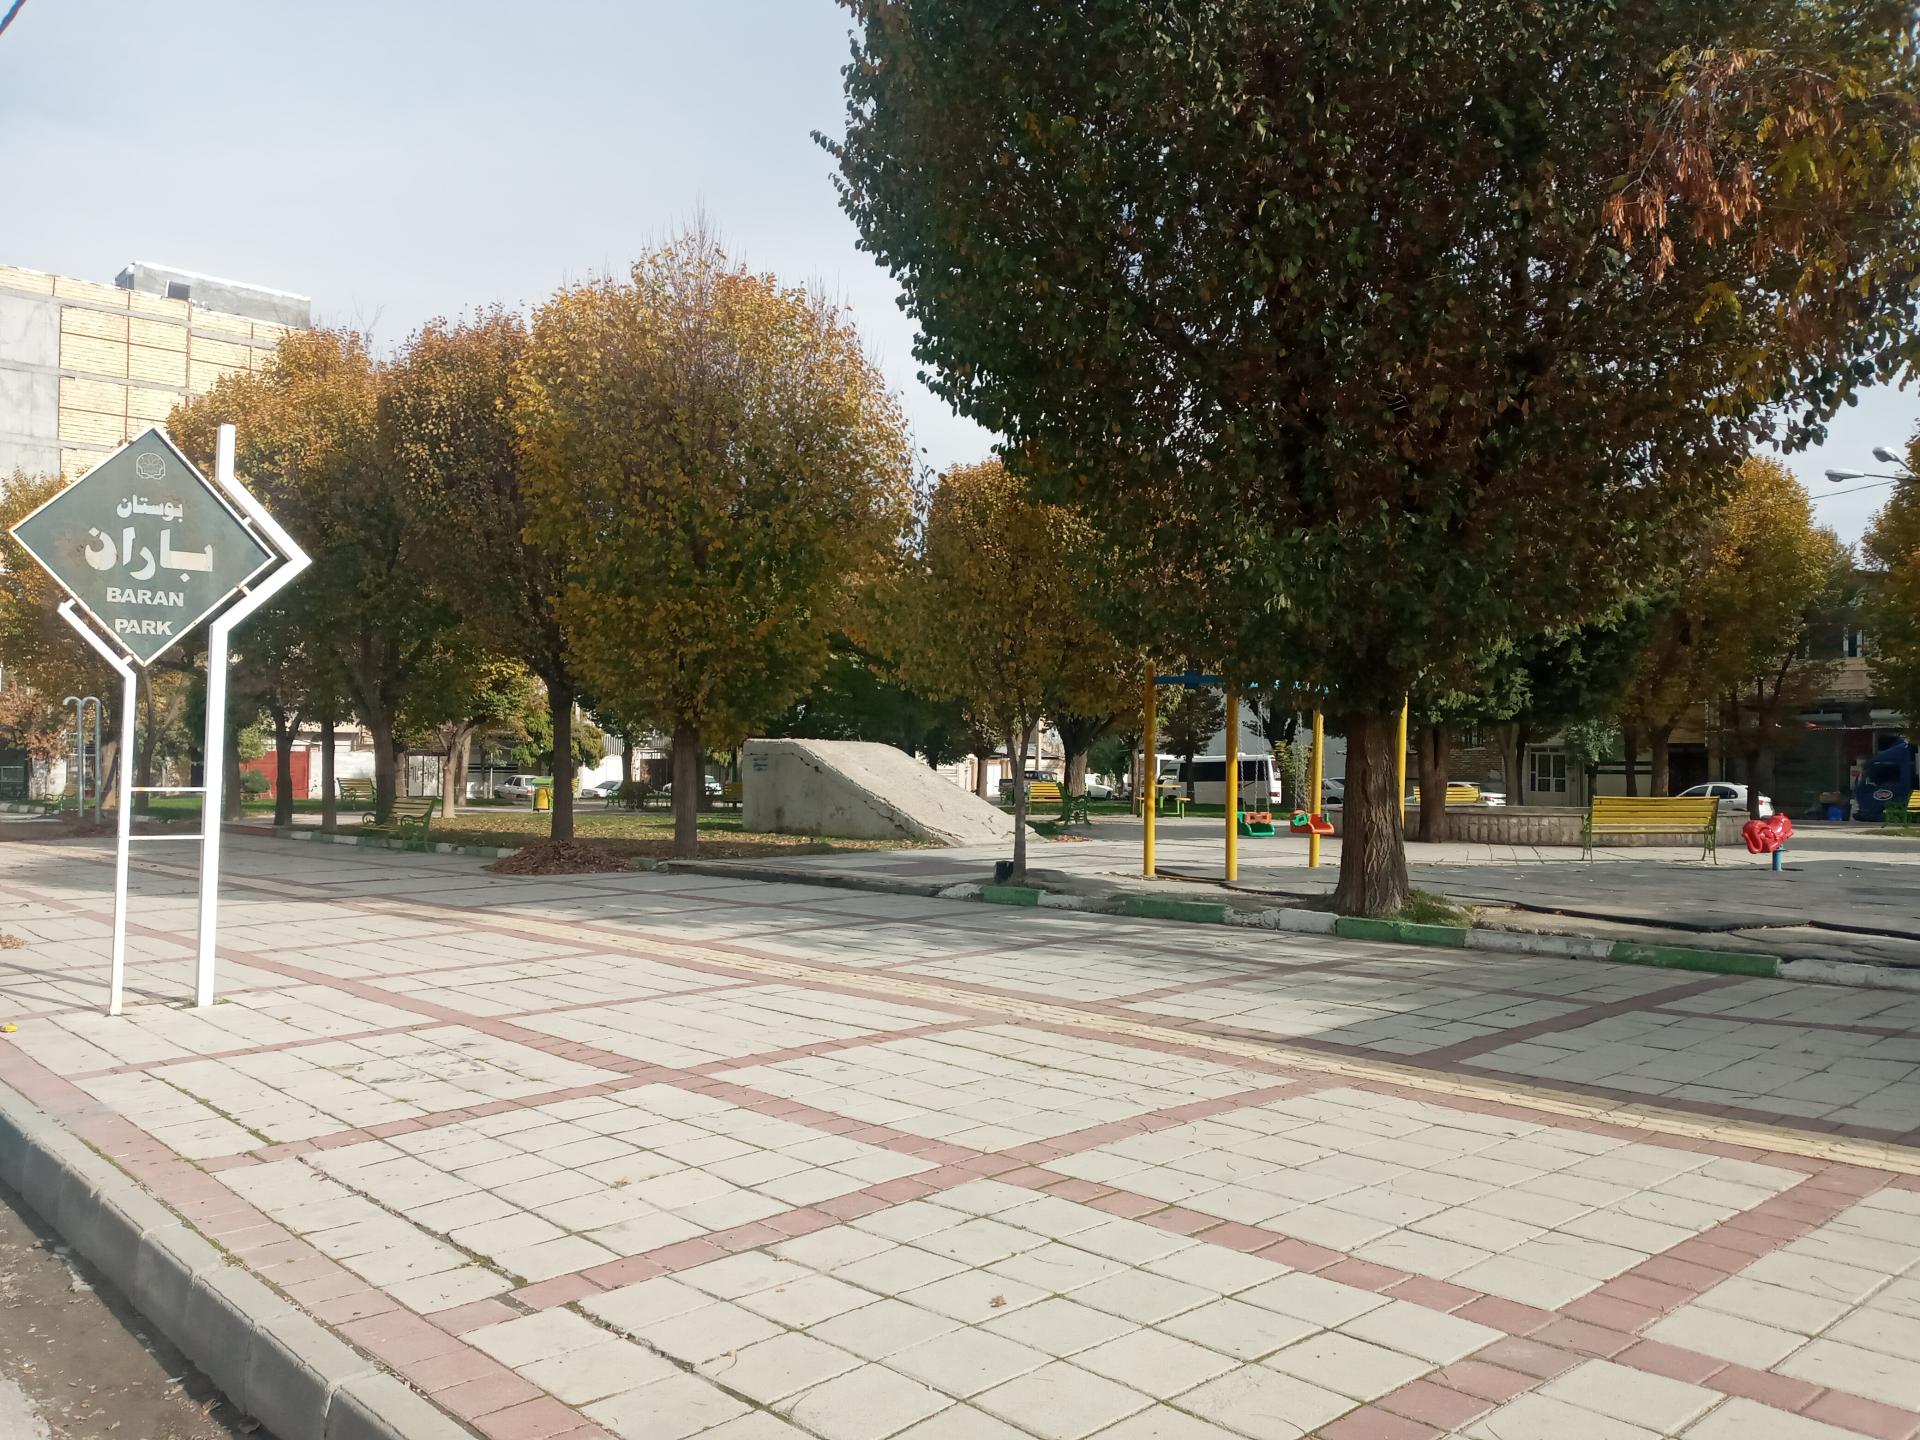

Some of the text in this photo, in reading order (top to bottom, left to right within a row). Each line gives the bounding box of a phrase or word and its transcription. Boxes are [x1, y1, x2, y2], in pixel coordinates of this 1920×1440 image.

[117, 494, 183, 522] بوستان
[85, 527, 213, 582] باران
[106, 587, 184, 607] BARAN
[115, 618, 173, 636] PARK
